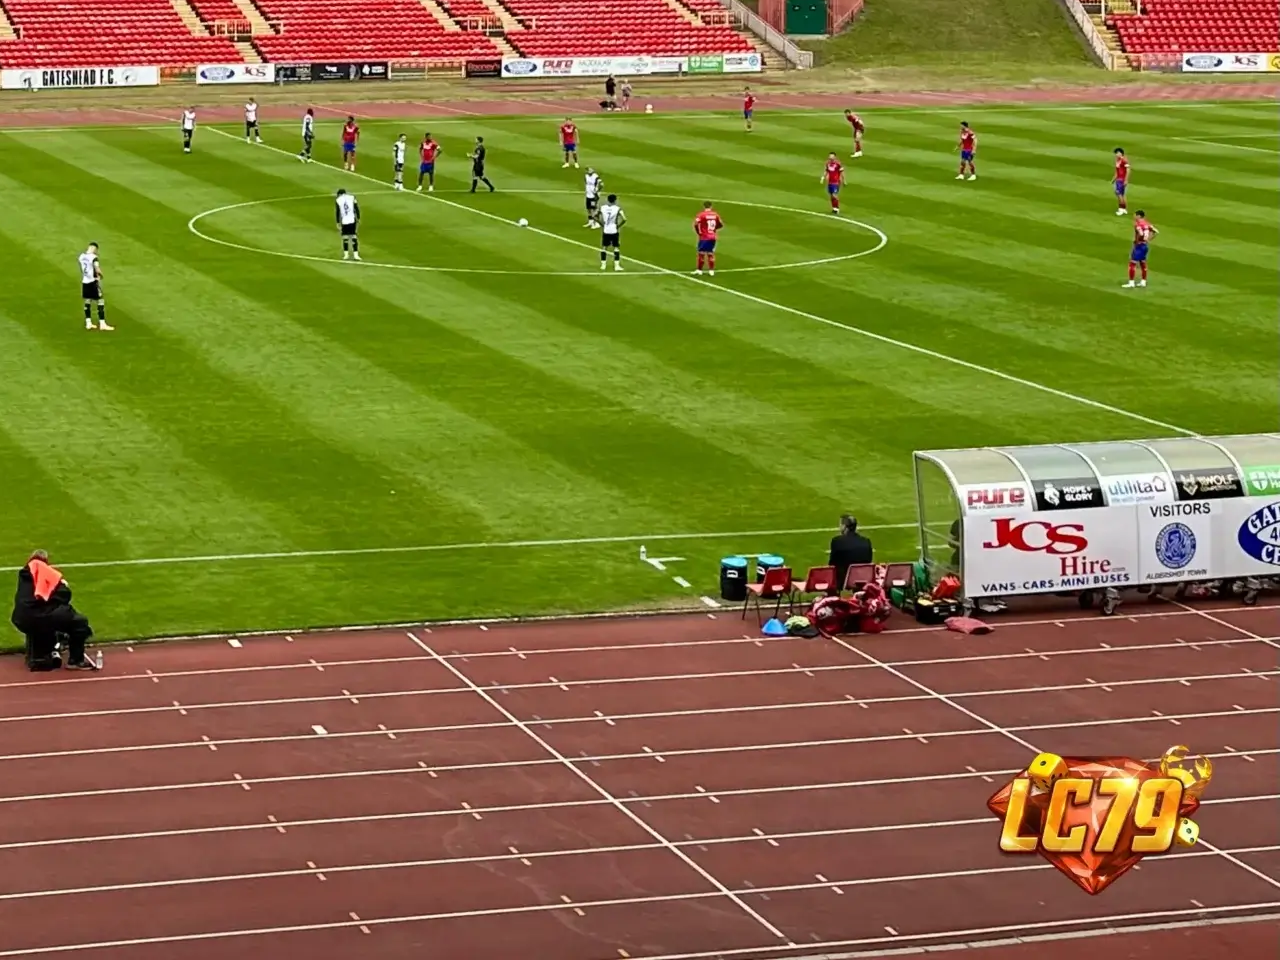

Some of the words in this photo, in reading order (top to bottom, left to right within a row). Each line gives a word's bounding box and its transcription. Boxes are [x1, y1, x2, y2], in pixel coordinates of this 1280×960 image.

[42, 70, 96, 86] GATESHEAD
[99, 70, 118, 84] F.C.
[1108, 479, 1154, 496] utilita
[967, 487, 1025, 506] pure
[1064, 493, 1093, 502] GLORY
[1149, 502, 1211, 518] VISITORS
[982, 517, 1089, 555] JCS
[1059, 556, 1112, 577] Hire
[1145, 570, 1186, 580] ALDERSHOT
[1187, 568, 1208, 577] TOWN
[981, 582, 1016, 593] VANS
[1022, 579, 1055, 590] CARS
[1060, 576, 1090, 588] MINI
[1093, 573, 1130, 583] BUSES
